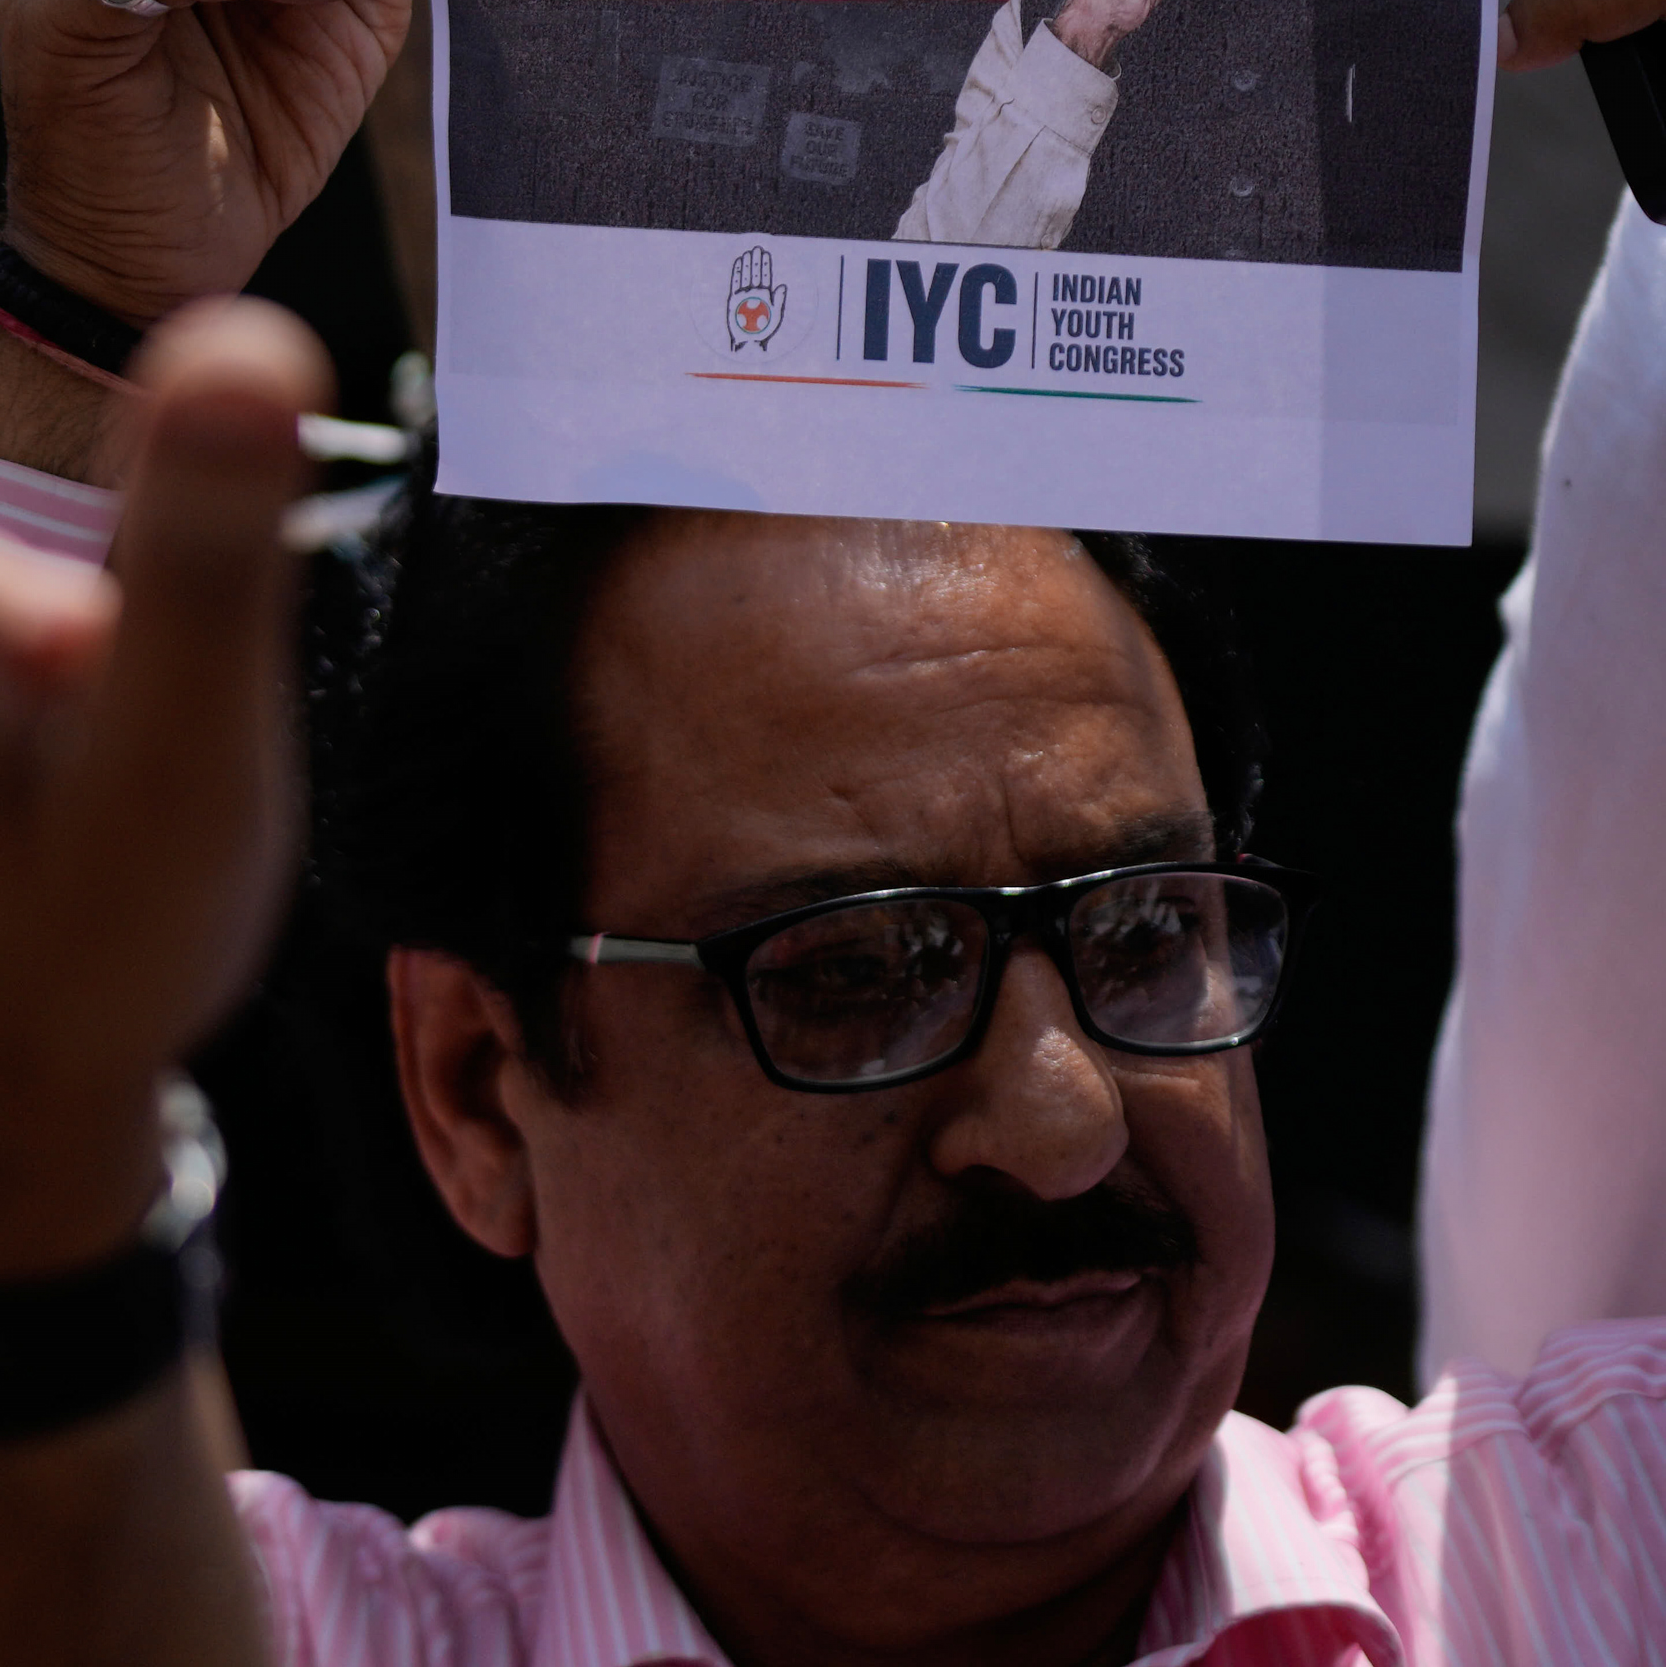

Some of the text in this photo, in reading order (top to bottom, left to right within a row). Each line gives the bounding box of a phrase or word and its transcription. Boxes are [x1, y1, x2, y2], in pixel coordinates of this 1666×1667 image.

[1052, 273, 1142, 306] INDIAN
[863, 258, 1017, 368] IYC
[1051, 308, 1135, 341] YOUTH
[1049, 342, 1185, 378] CONGRESS
